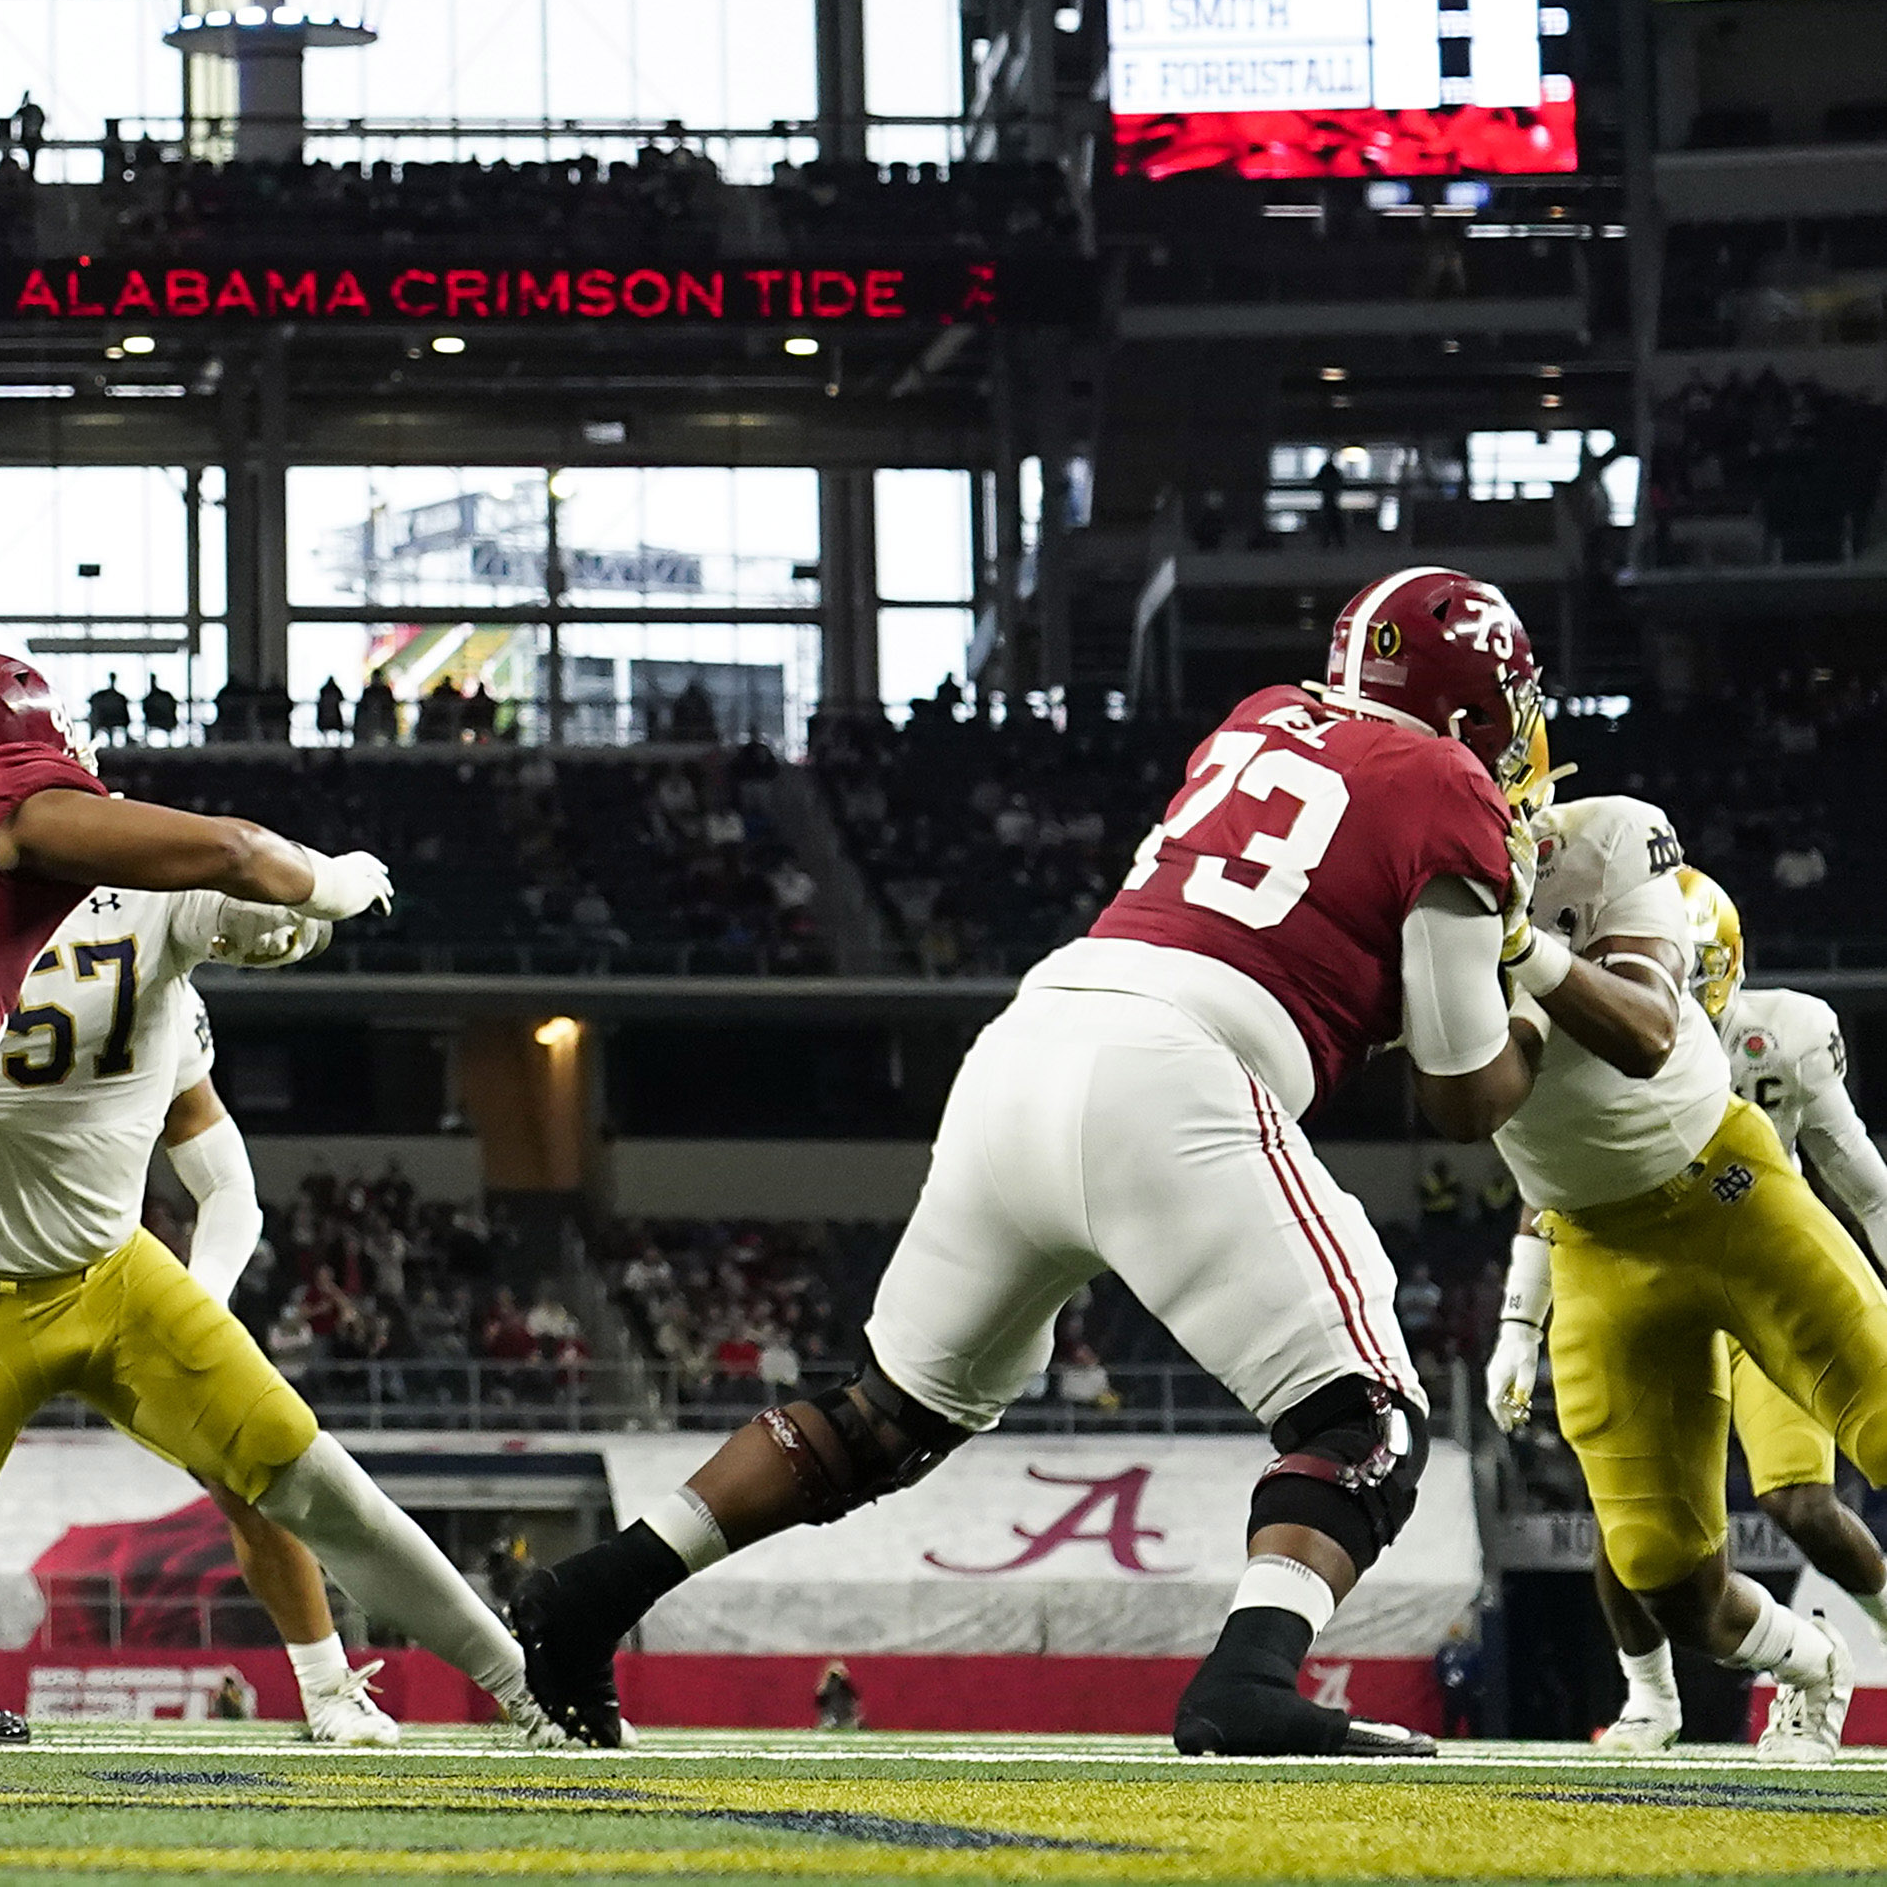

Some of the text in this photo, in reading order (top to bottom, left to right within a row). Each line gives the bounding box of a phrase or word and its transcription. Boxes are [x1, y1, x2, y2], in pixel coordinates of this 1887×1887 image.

[1161, 57, 1365, 101] FORRISTALL
[17, 268, 369, 317] ALABAMA
[390, 268, 724, 317] CRIMSON
[745, 268, 905, 317] TIDE
[1122, 730, 1351, 930] 73
[1, 932, 141, 1090] 57
